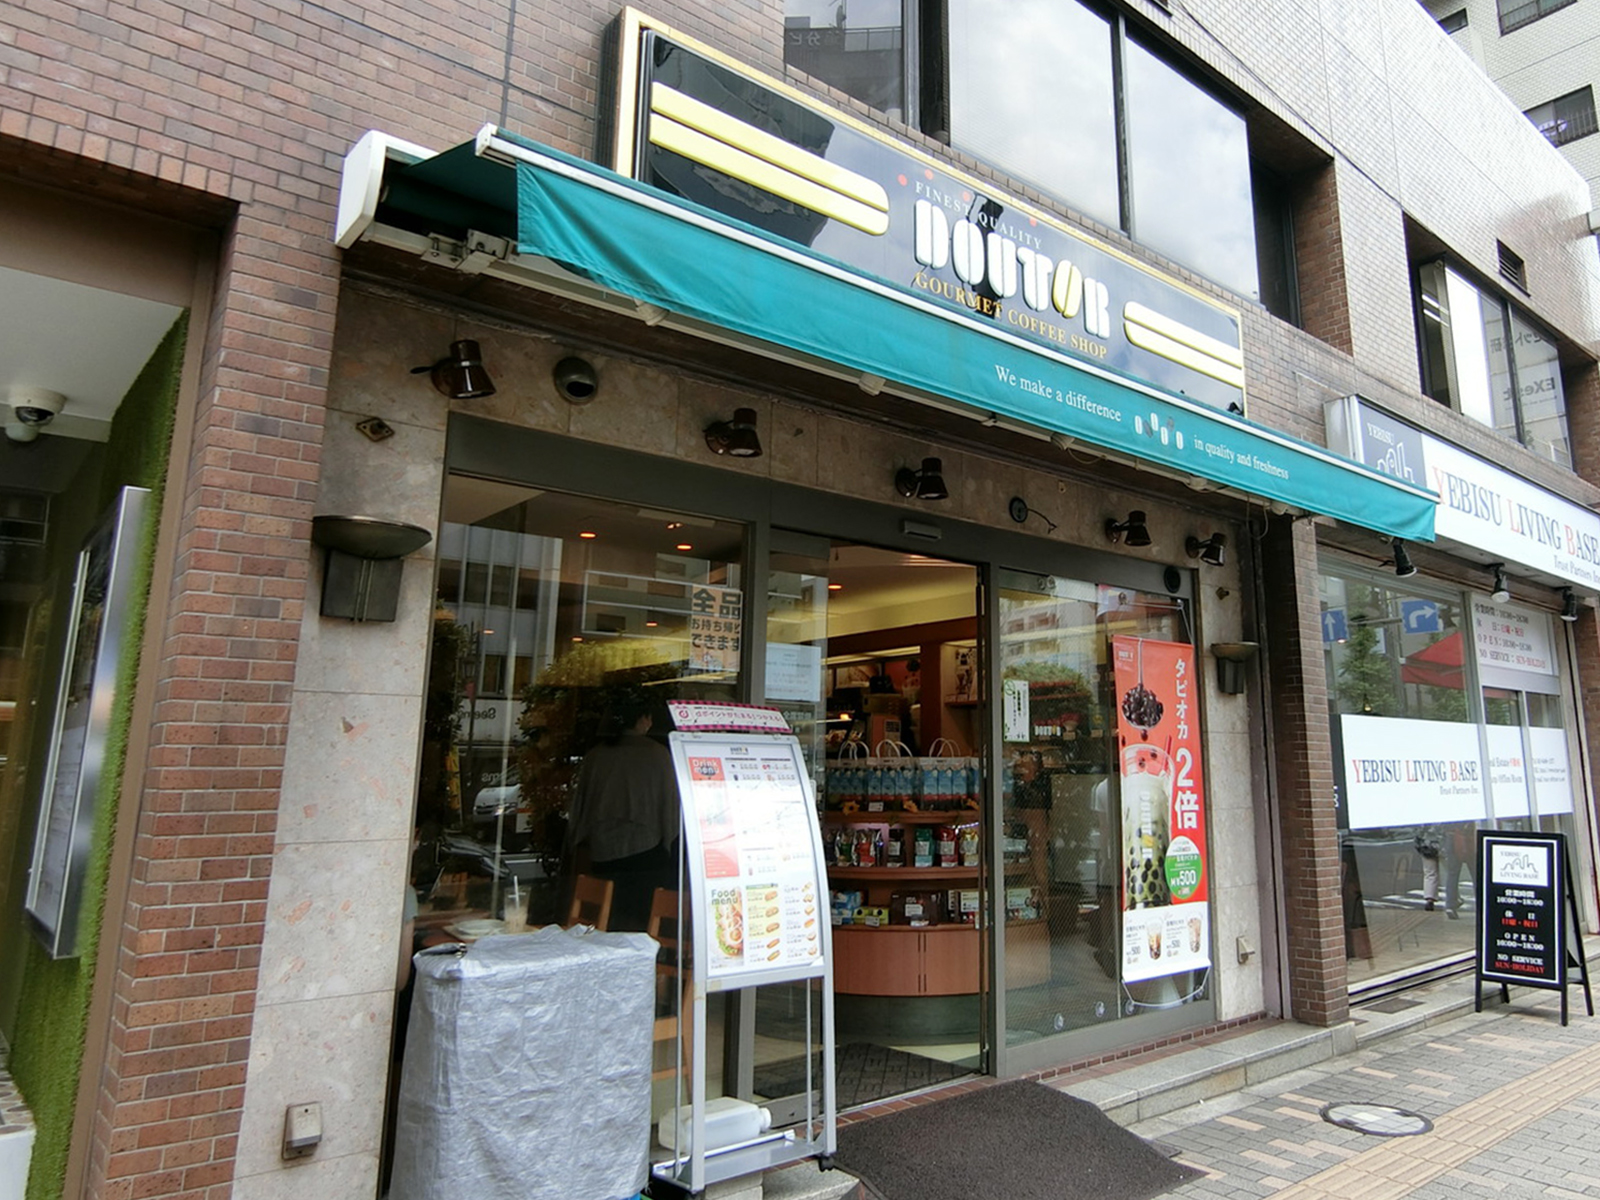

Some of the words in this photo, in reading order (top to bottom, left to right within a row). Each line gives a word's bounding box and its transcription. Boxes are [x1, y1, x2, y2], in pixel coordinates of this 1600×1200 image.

[915, 181, 970, 217] FINEST
[978, 211, 1042, 250] QUALITY
[914, 199, 1110, 339] DOUTOR
[915, 271, 1003, 319] GOURMET
[1008, 309, 1067, 344] COFFEE
[1070, 334, 1107, 359] SHOP
[995, 364, 1017, 386] We
[1020, 377, 1053, 399] make
[1055, 391, 1063, 403] a
[1065, 393, 1122, 422] difference
[1366, 422, 1395, 446] YEBISU
[1194, 435, 1204, 450] in
[1205, 438, 1236, 464] quality
[1237, 451, 1252, 467] and
[1252, 455, 1290, 480] freshness
[1432, 466, 1502, 526] YEBISU
[1506, 499, 1561, 550] LIVING
[1563, 523, 1600, 566] BASE
[693, 588, 741, 619] 全品
[692, 618, 740, 634] お持ち帰り
[692, 633, 740, 651] できます
[692, 759, 718, 767] Drink
[693, 766, 720, 774] menu
[1352, 759, 1402, 783] YEBISU
[1405, 759, 1447, 783] LIVING
[1449, 760, 1479, 782] BASE
[711, 888, 736, 898] Food
[711, 897, 739, 906] menu
[1497, 953, 1509, 961] NO
[1512, 955, 1544, 965] SERVICE
